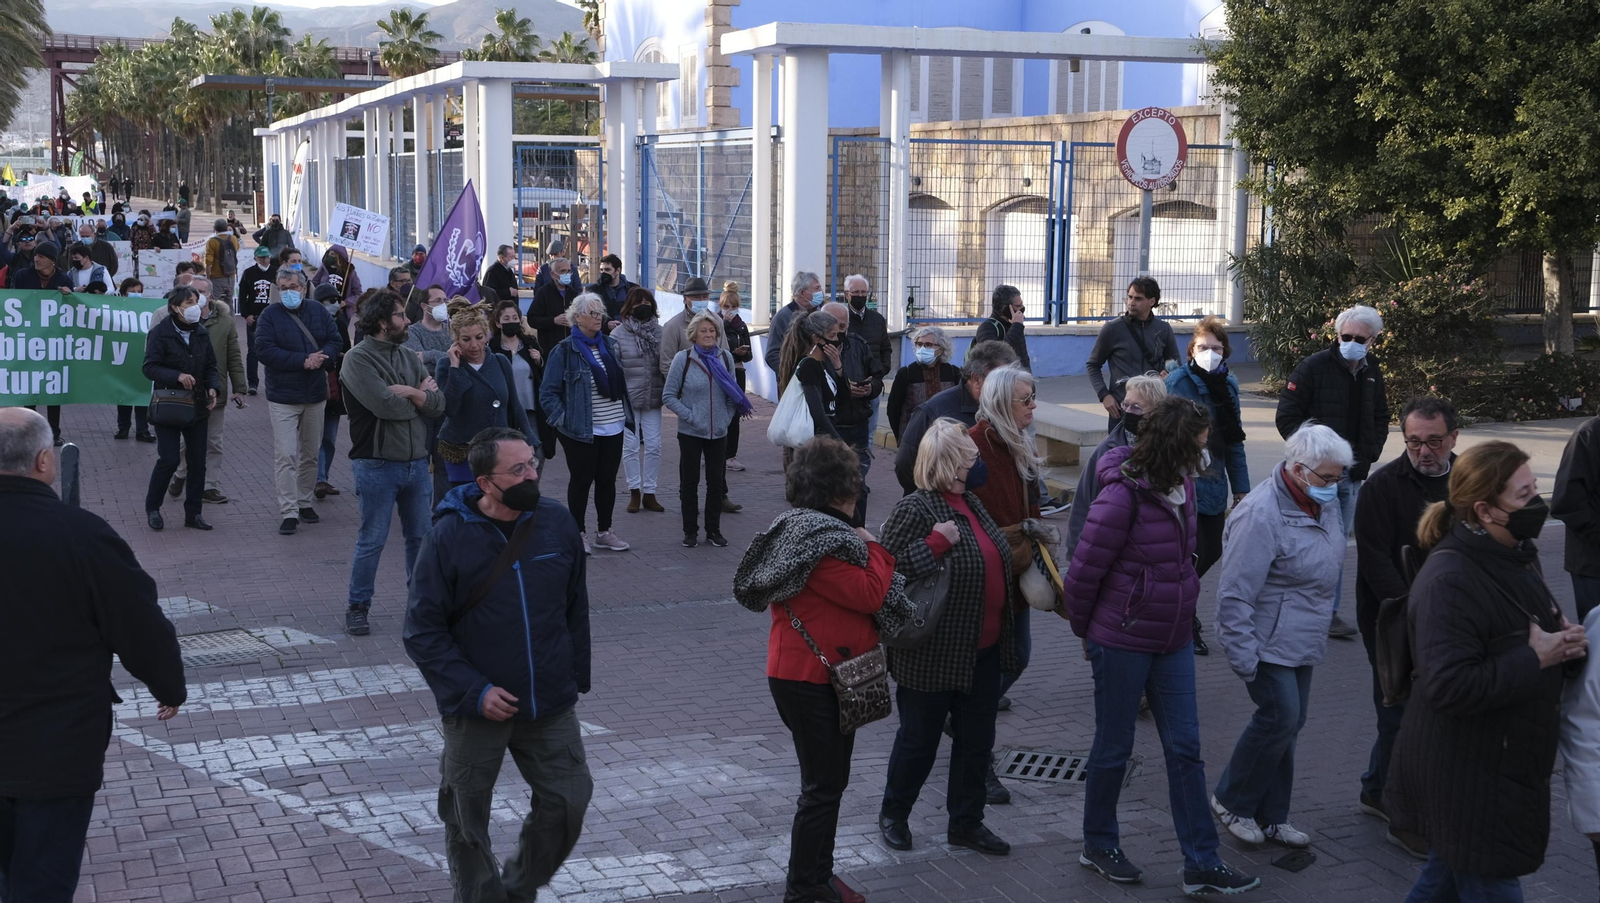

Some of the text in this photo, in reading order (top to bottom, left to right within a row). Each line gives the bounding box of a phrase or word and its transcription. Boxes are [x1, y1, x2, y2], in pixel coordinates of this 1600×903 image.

[1131, 108, 1176, 126] EXCEPTO
[1148, 159, 1183, 190] AUTORIZADOS
[111, 341, 129, 366] y
